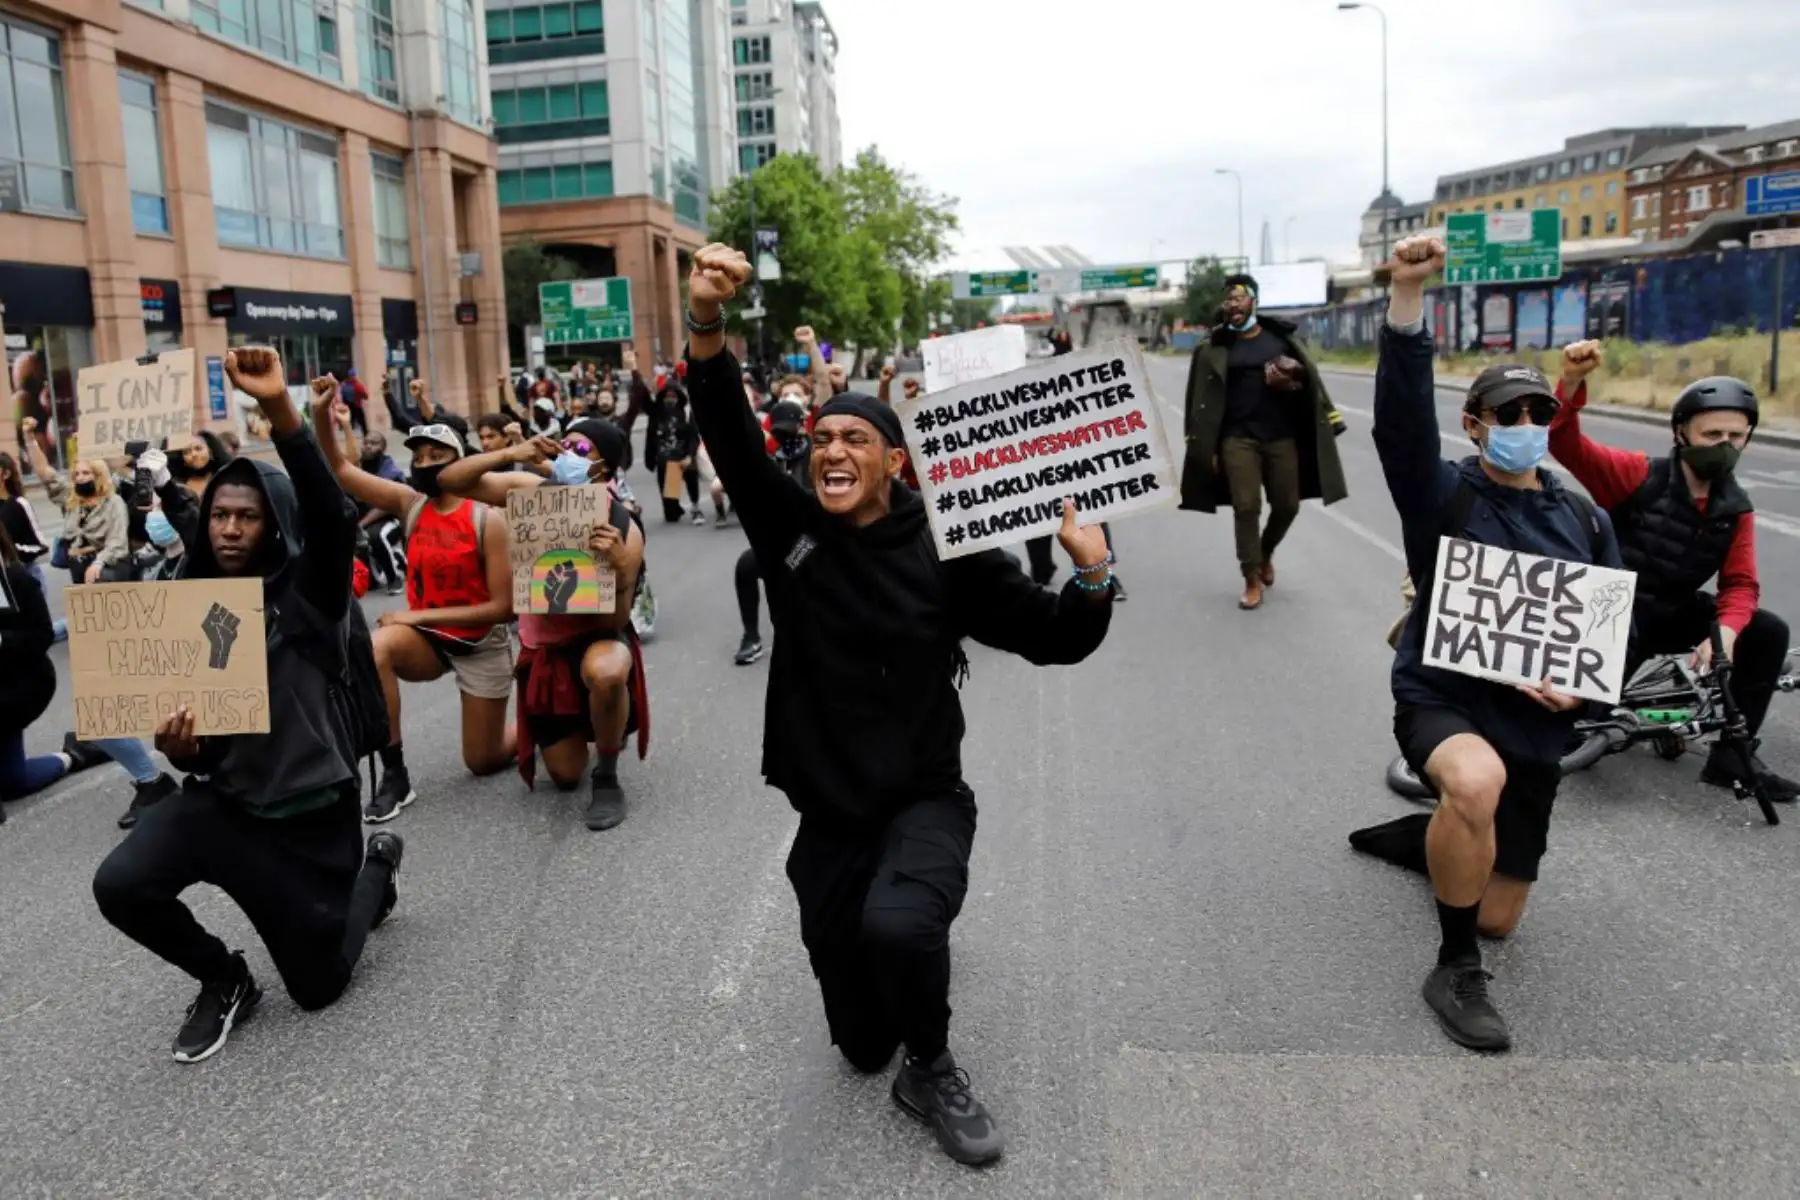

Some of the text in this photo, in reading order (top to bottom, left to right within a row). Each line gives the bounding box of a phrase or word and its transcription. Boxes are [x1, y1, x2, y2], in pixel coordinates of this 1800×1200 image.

[246, 302, 266, 319] Open
[288, 304, 300, 322] day
[86, 383, 109, 414] I
[117, 365, 188, 410] CAN'T
[914, 358, 1126, 432] #BLACKLIVESMATTER
[921, 383, 1135, 457] #BLACKLIVESMATTER
[94, 410, 191, 445] BREATHE
[927, 410, 1147, 485] #BLACKLIVESMATTER
[936, 442, 1151, 513] #BLACKLIVESMATTER
[945, 473, 1160, 546] #BLACKLIVEMATTER
[1444, 539, 1587, 607] BLACK
[70, 588, 168, 633] HOW
[1438, 582, 1583, 644] LIVES
[107, 638, 201, 677] MANY
[1431, 617, 1611, 693] MATTER
[76, 694, 151, 736] MORE
[202, 688, 265, 731] US?
